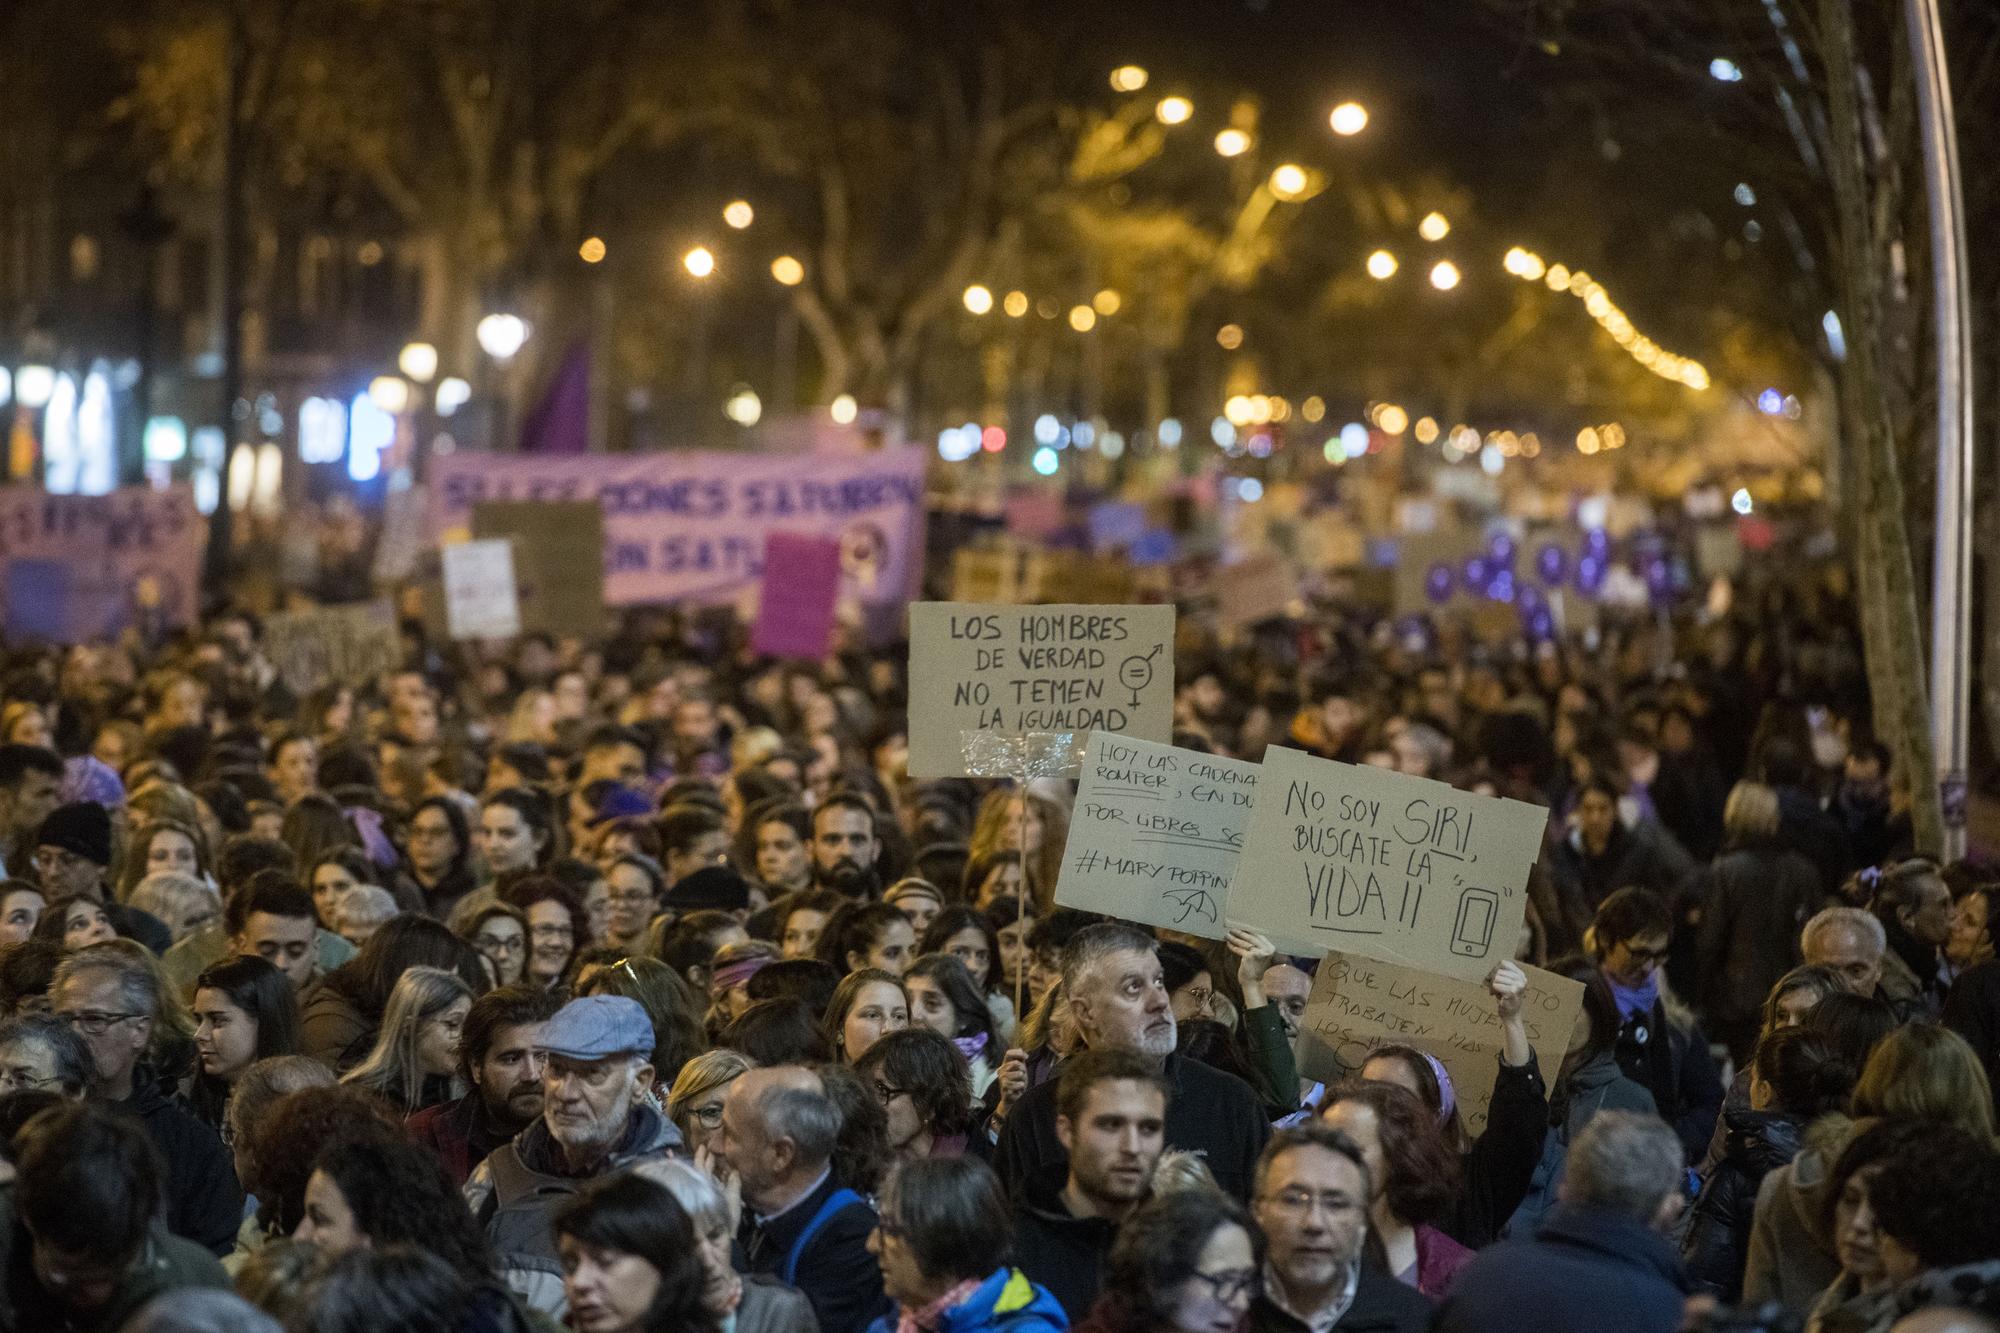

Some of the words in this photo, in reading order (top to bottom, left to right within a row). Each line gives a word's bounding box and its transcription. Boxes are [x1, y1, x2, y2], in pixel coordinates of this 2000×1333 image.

[951, 615, 1001, 640] LOS
[1020, 614, 1129, 644] HOMBRES
[975, 648, 1004, 671] DE
[1018, 647, 1105, 670] VERDAD
[954, 681, 990, 706] NO
[1010, 679, 1105, 705] TEMEN
[978, 707, 1005, 730] LA
[1018, 708, 1128, 732] IGUALDAD
[1100, 742, 1139, 766] HOY
[1147, 754, 1178, 772] LAS
[1188, 763, 1261, 787] CADENA
[1191, 785, 1224, 804] EN
[1285, 780, 1326, 818] NO
[1339, 795, 1381, 828] SOY
[1084, 803, 1130, 825] POR
[1220, 828, 1245, 847] SE
[1168, 866, 1233, 890] POPPIN
[1406, 849, 1432, 884] LA
[1326, 991, 1435, 1035] TRABAJEN
[1328, 960, 1379, 989] QUE
[1388, 980, 1436, 1007] LAS
[1446, 997, 1541, 1040] MUJES
[1314, 1019, 1353, 1042] LOS
